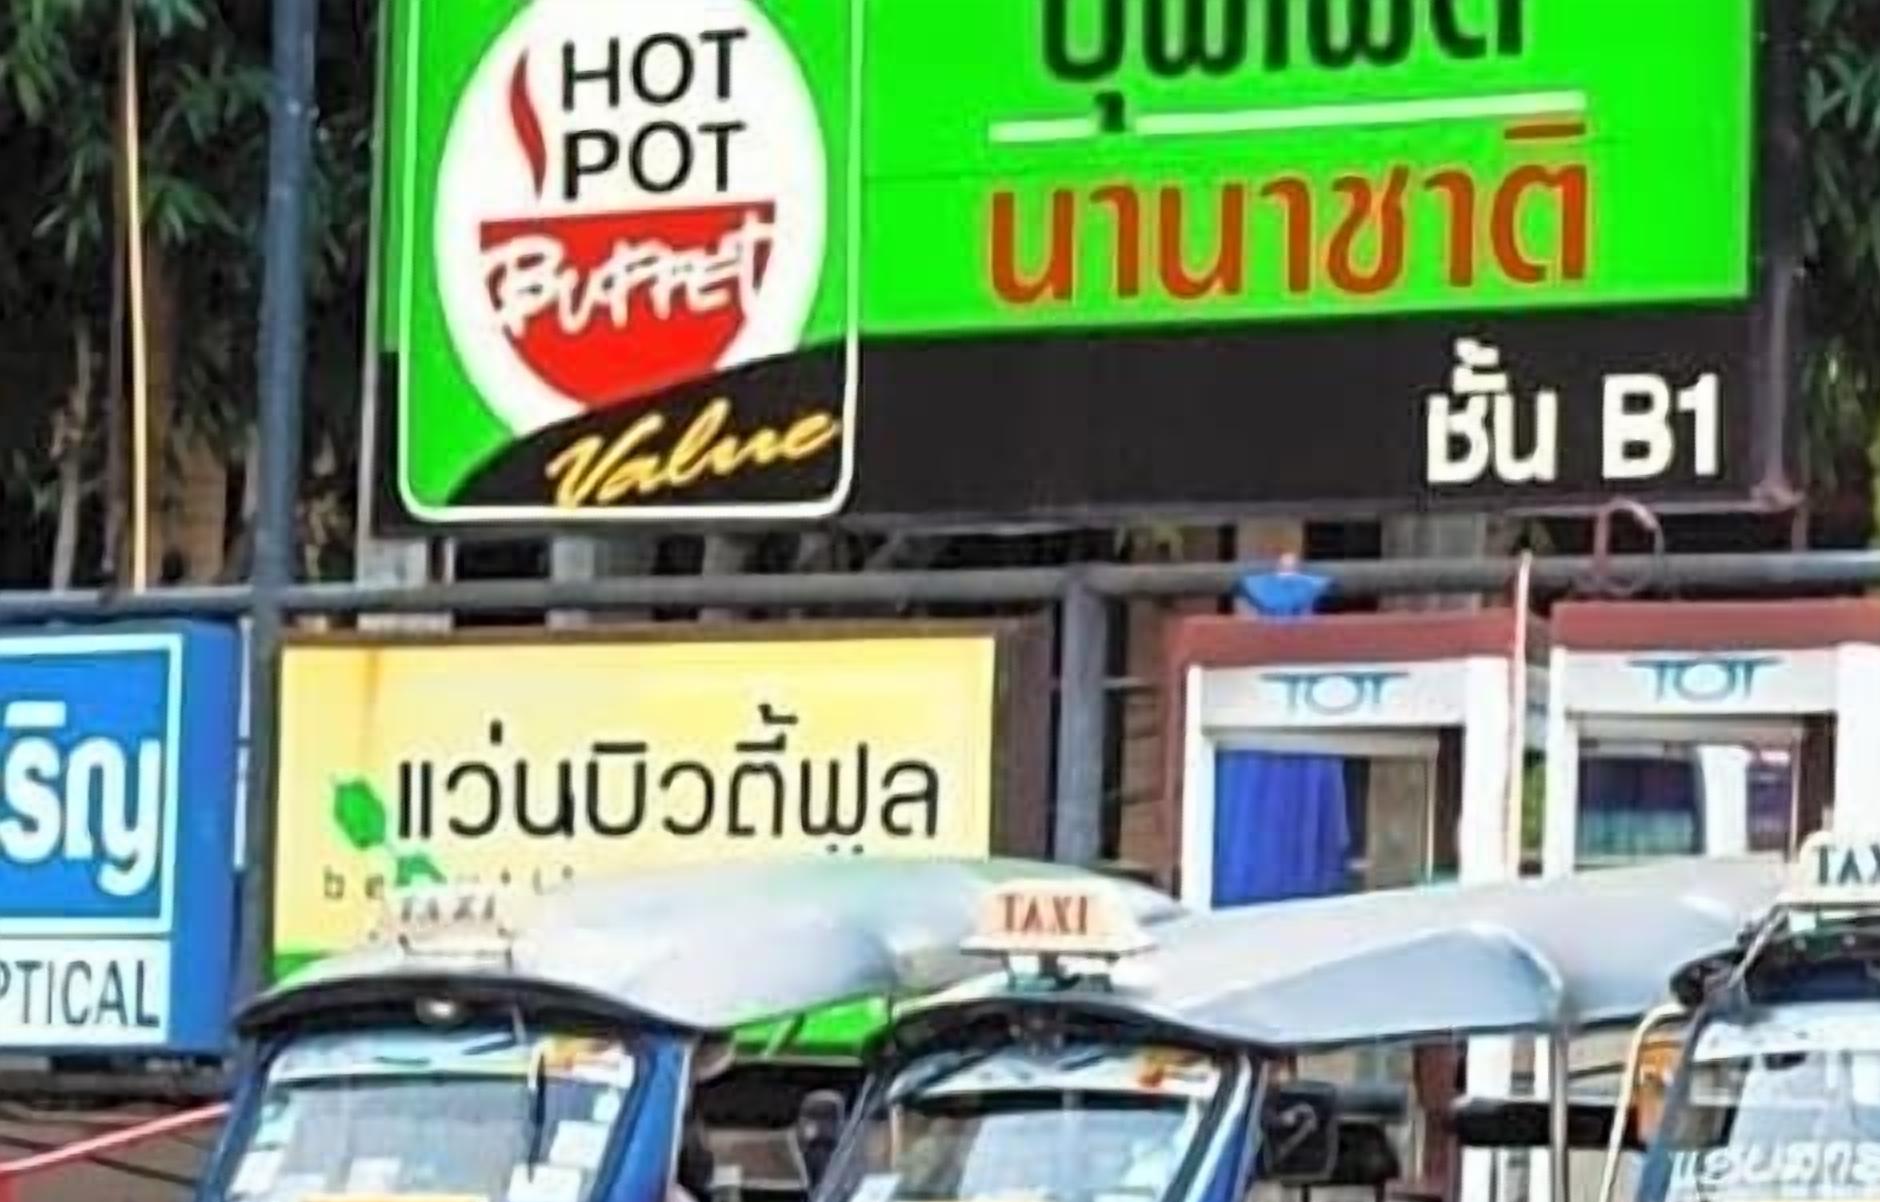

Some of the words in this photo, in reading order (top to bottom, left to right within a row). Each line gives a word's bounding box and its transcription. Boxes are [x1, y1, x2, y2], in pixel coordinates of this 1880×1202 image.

[560, 27, 748, 111] HOT
[561, 120, 748, 201] POT
[988, 121, 1588, 305] นานาชาติ
[1425, 336, 1560, 484] ชั้น
[1602, 373, 1720, 480] B1
[544, 396, 843, 511] Value
[1259, 671, 1411, 716] TOT
[1625, 655, 1785, 702] TOT
[996, 893, 1088, 935] TAXI
